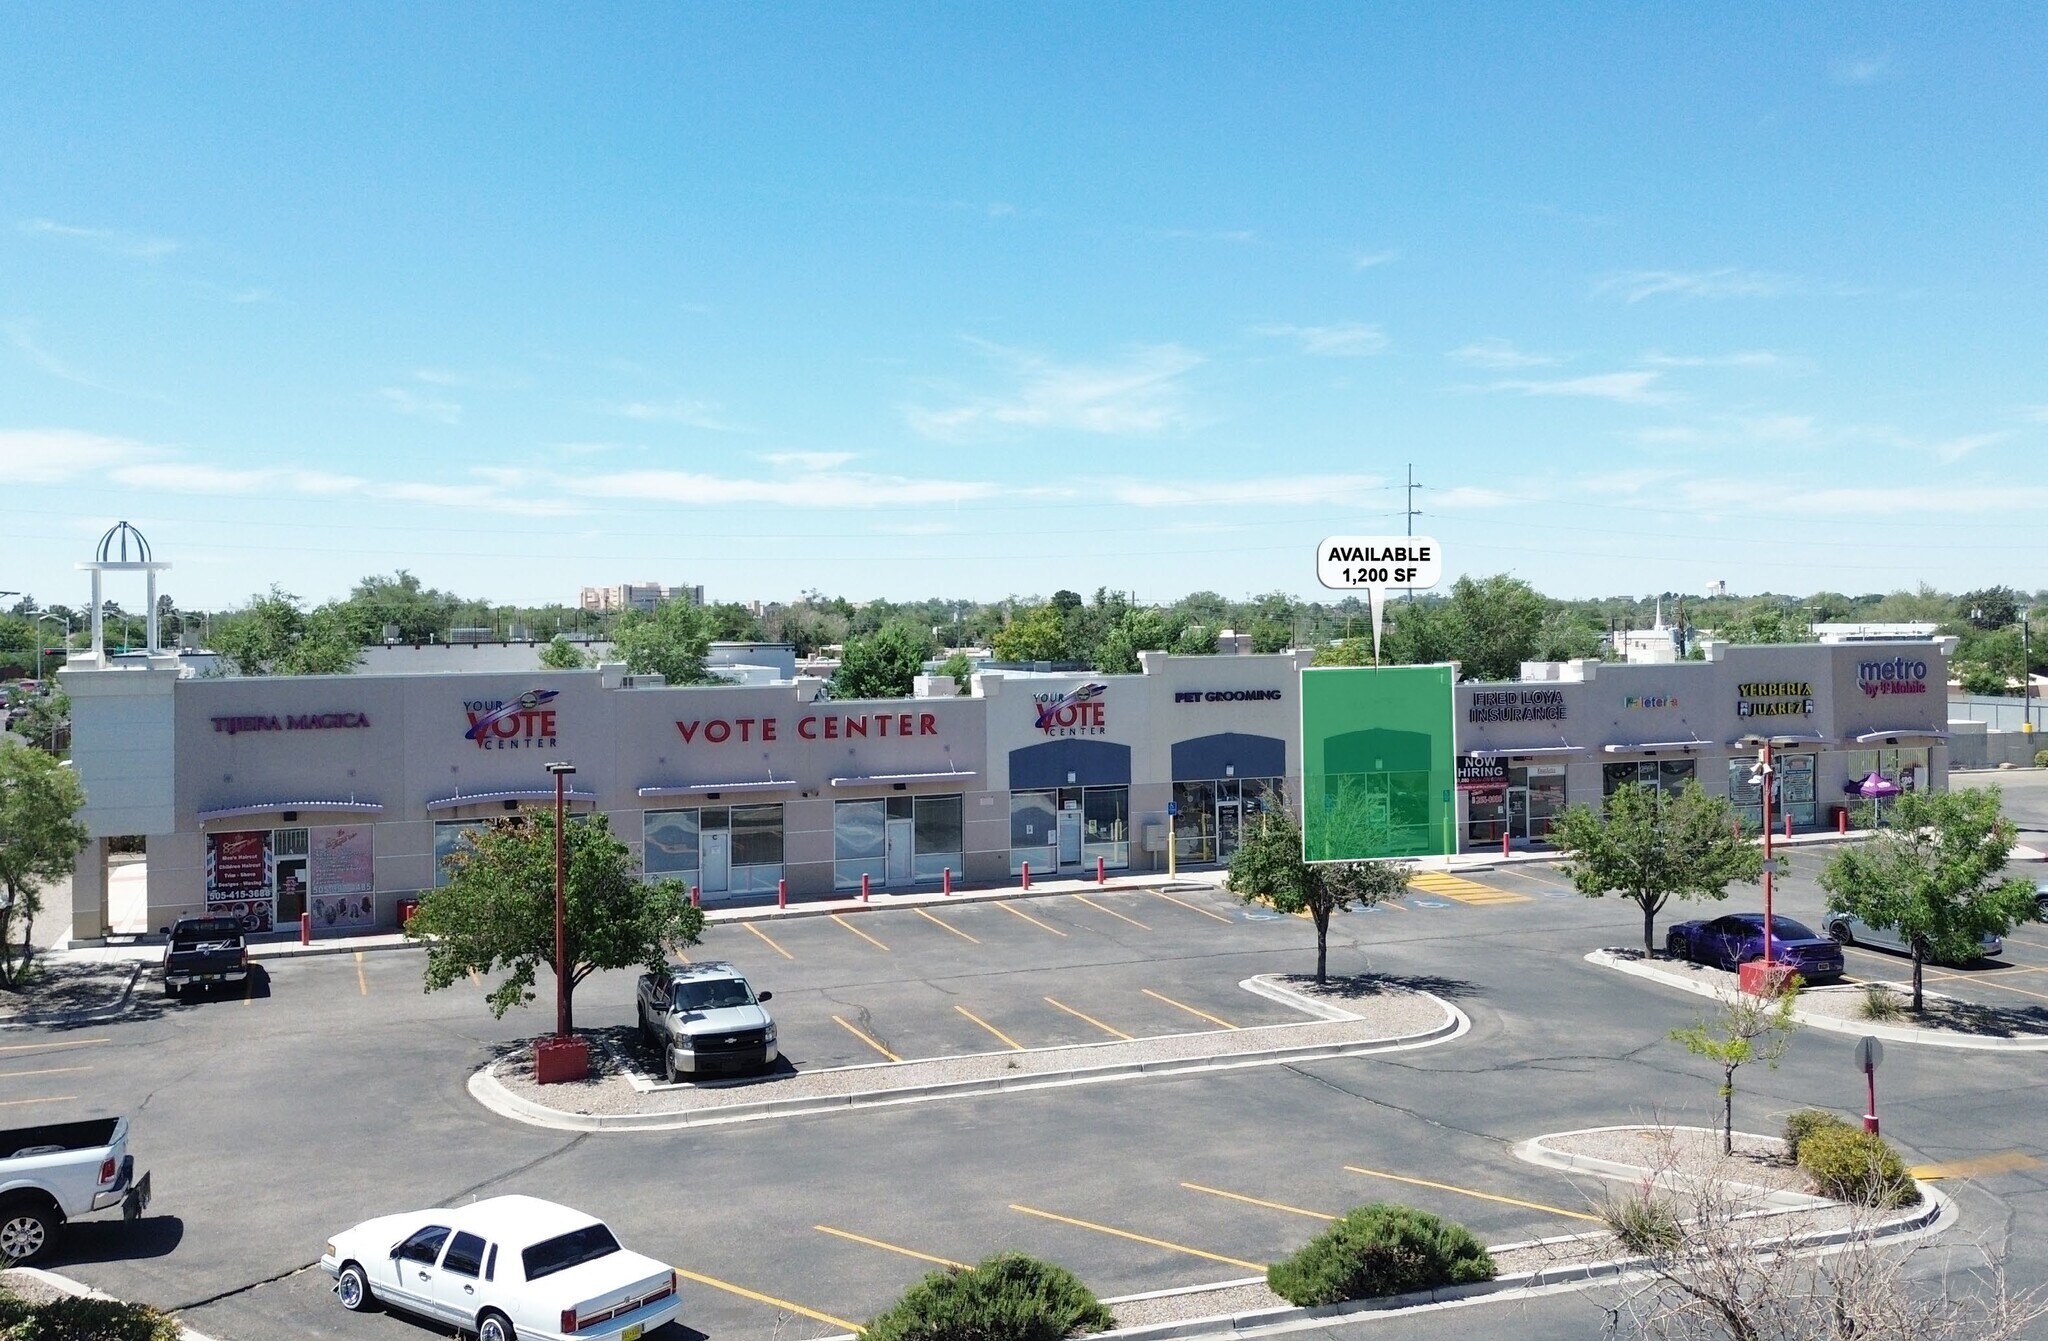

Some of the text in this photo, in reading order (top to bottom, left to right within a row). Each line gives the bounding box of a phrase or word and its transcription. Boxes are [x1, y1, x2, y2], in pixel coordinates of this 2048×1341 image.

[1858, 657, 1928, 681] metro
[1033, 693, 1065, 703] YOUR
[1174, 689, 1282, 704] PET GROOMING
[1472, 689, 1565, 707] FRED LOYA
[1738, 682, 1813, 698] YERBERIA
[1864, 682, 1879, 698] by
[463, 700, 504, 711] YOUR
[1749, 702, 1804, 718] JUAREZ
[1035, 702, 1106, 736] VOTE
[1469, 706, 1567, 723] INSURANCE
[211, 712, 370, 735] TIJERA MAGICA
[467, 710, 557, 749] VOTE
[675, 713, 938, 744] VOTE CENTER
[1049, 727, 1106, 737] CENTER
[484, 738, 557, 750] CENTER
[1465, 757, 1497, 768] NOW
[1458, 766, 1504, 778] HIRING
